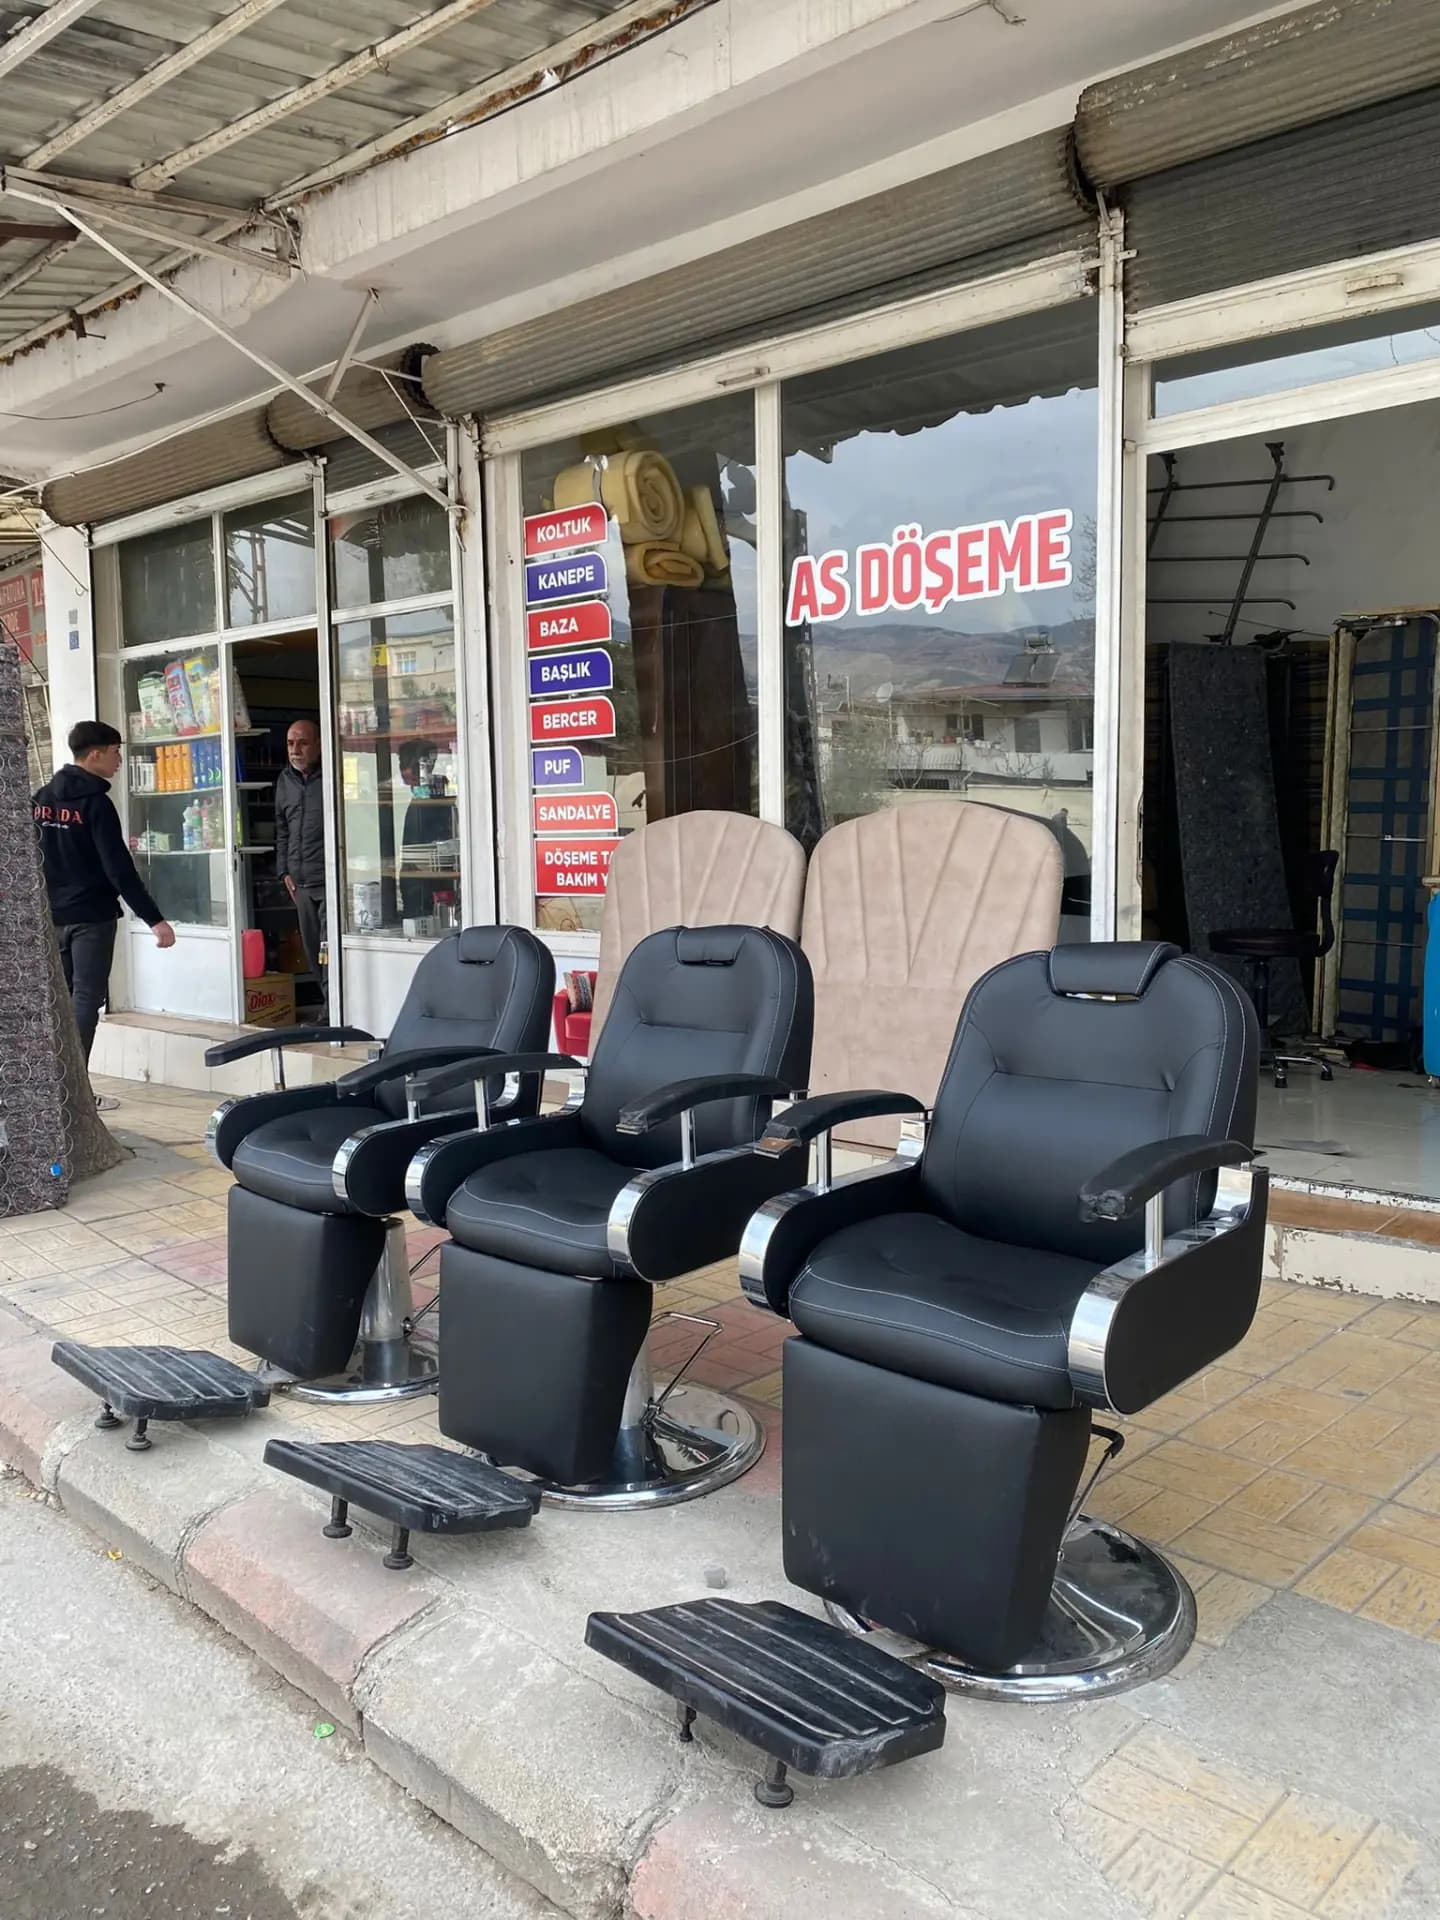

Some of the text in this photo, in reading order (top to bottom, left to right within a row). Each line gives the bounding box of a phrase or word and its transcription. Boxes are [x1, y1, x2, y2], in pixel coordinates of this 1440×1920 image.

[537, 516, 592, 543] KOLTUK
[538, 564, 595, 591] KANEPE
[788, 511, 1071, 625] AS DÖŞEME
[539, 616, 579, 638] BAZA
[541, 661, 591, 683] BAŞLIK
[544, 758, 571, 776] PUF
[539, 804, 611, 822] SANDALYE
[544, 848, 598, 868] DÖŞEME
[556, 872, 598, 887] BAKIM
